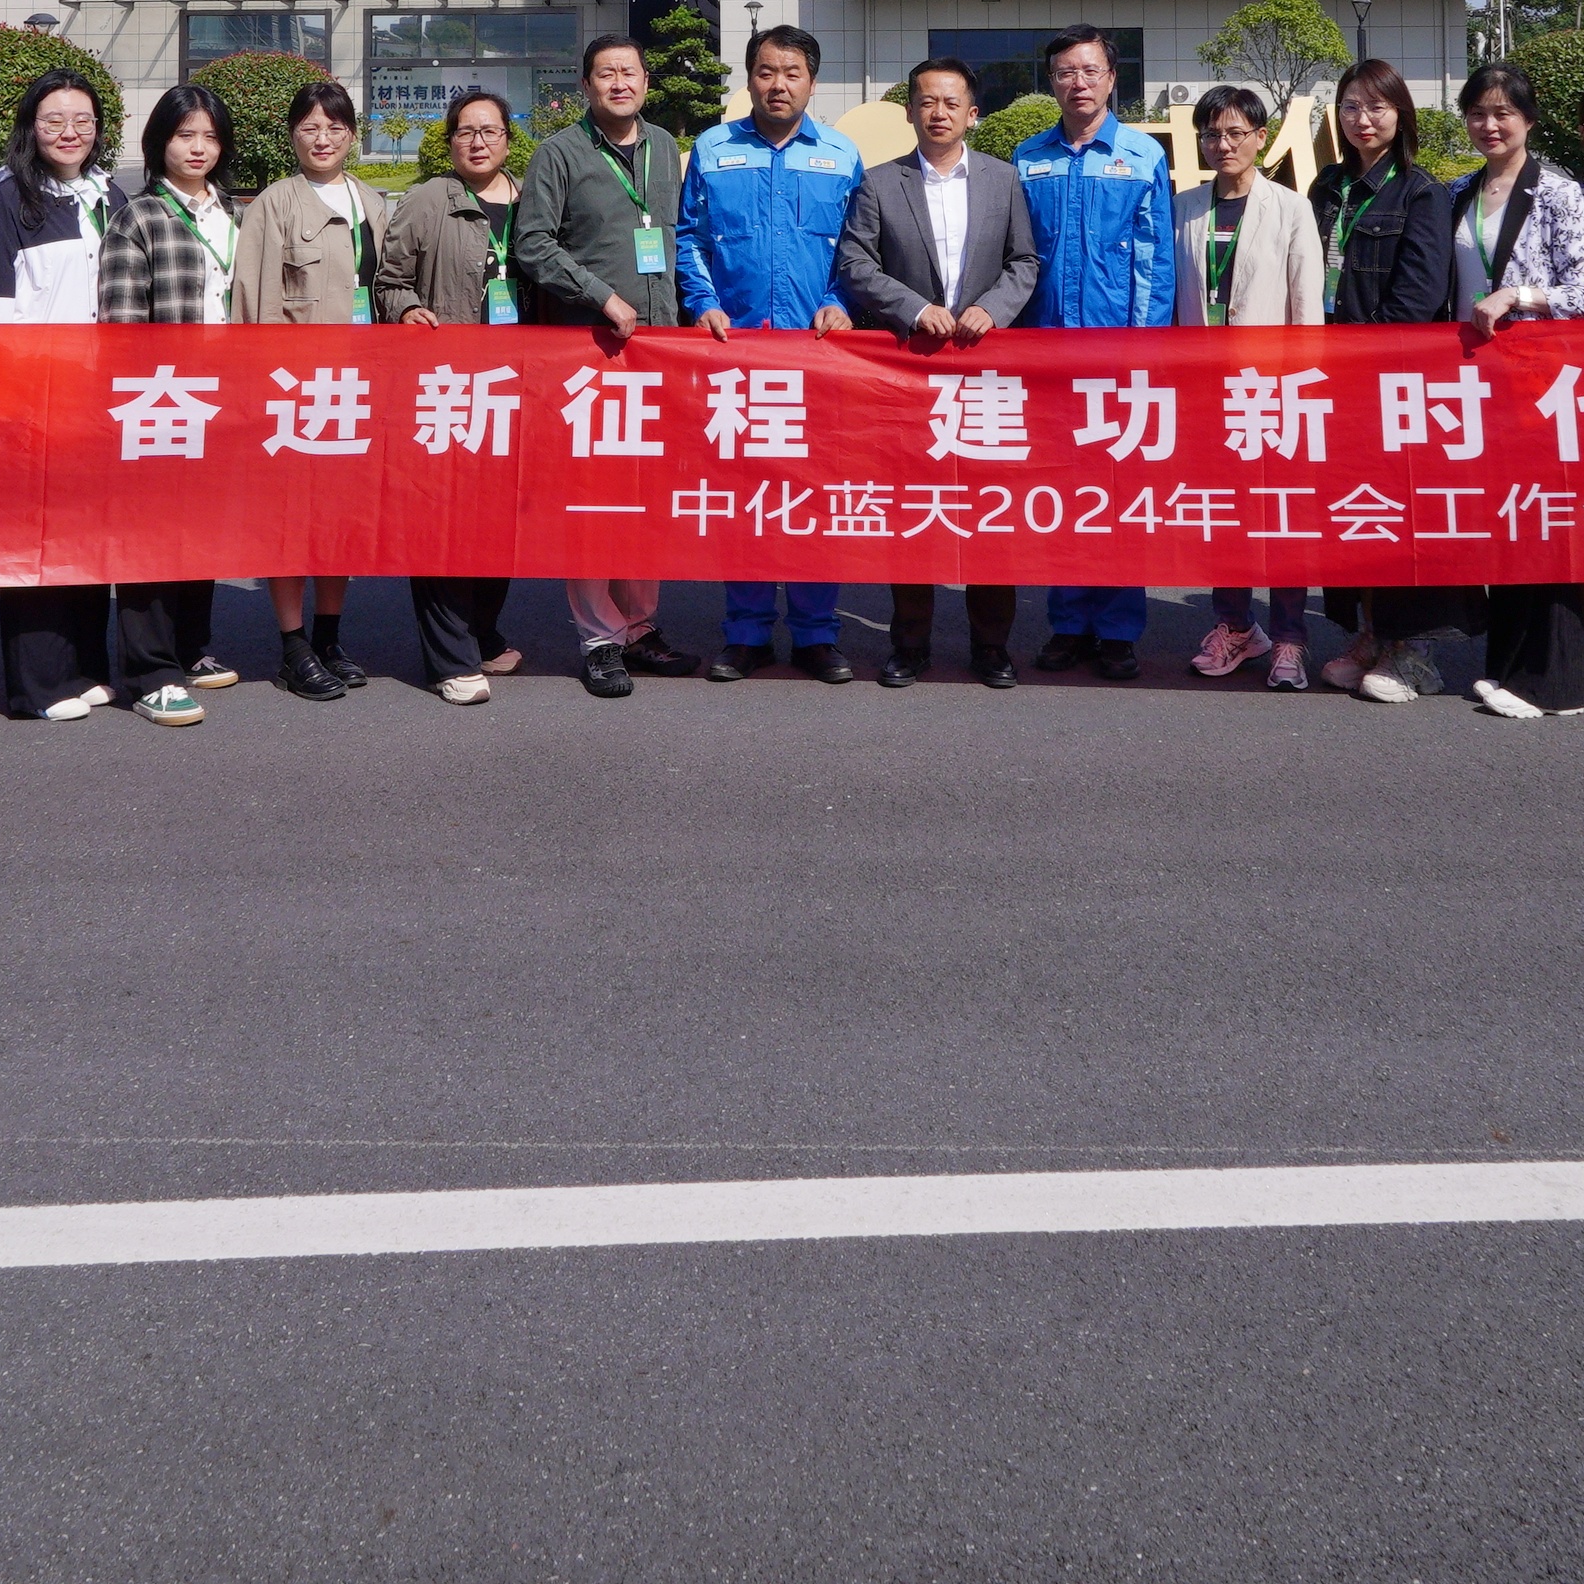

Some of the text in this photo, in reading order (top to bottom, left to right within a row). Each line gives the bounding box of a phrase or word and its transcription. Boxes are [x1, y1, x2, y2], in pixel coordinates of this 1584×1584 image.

[108, 363, 809, 461] 奋进新征程
